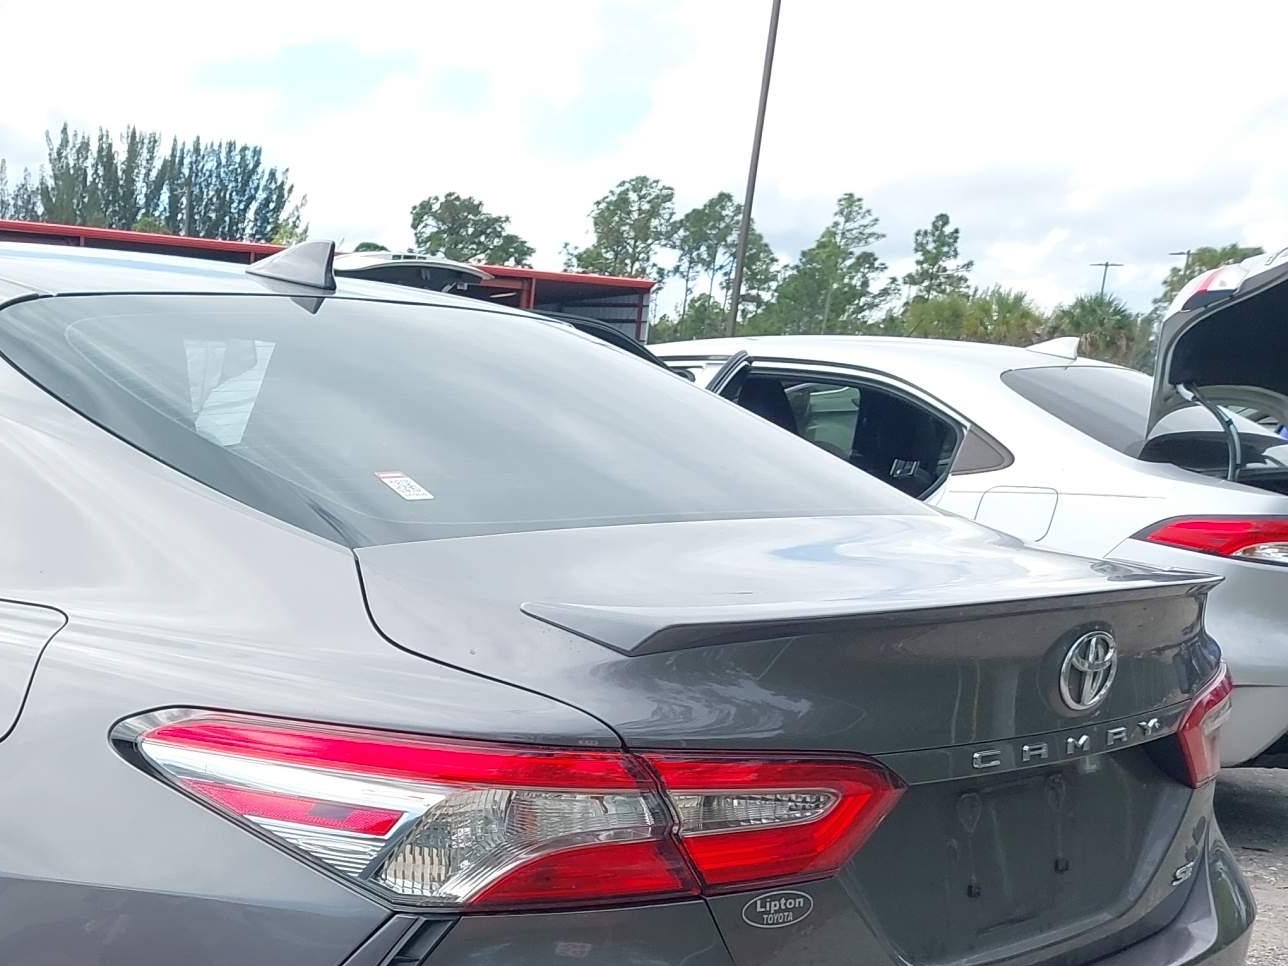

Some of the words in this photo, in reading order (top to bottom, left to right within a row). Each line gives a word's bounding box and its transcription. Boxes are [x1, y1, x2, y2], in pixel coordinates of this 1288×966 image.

[972, 717, 1161, 769] CAMRY
[756, 897, 804, 913] Lipton
[763, 911, 793, 925] TOYOTA
